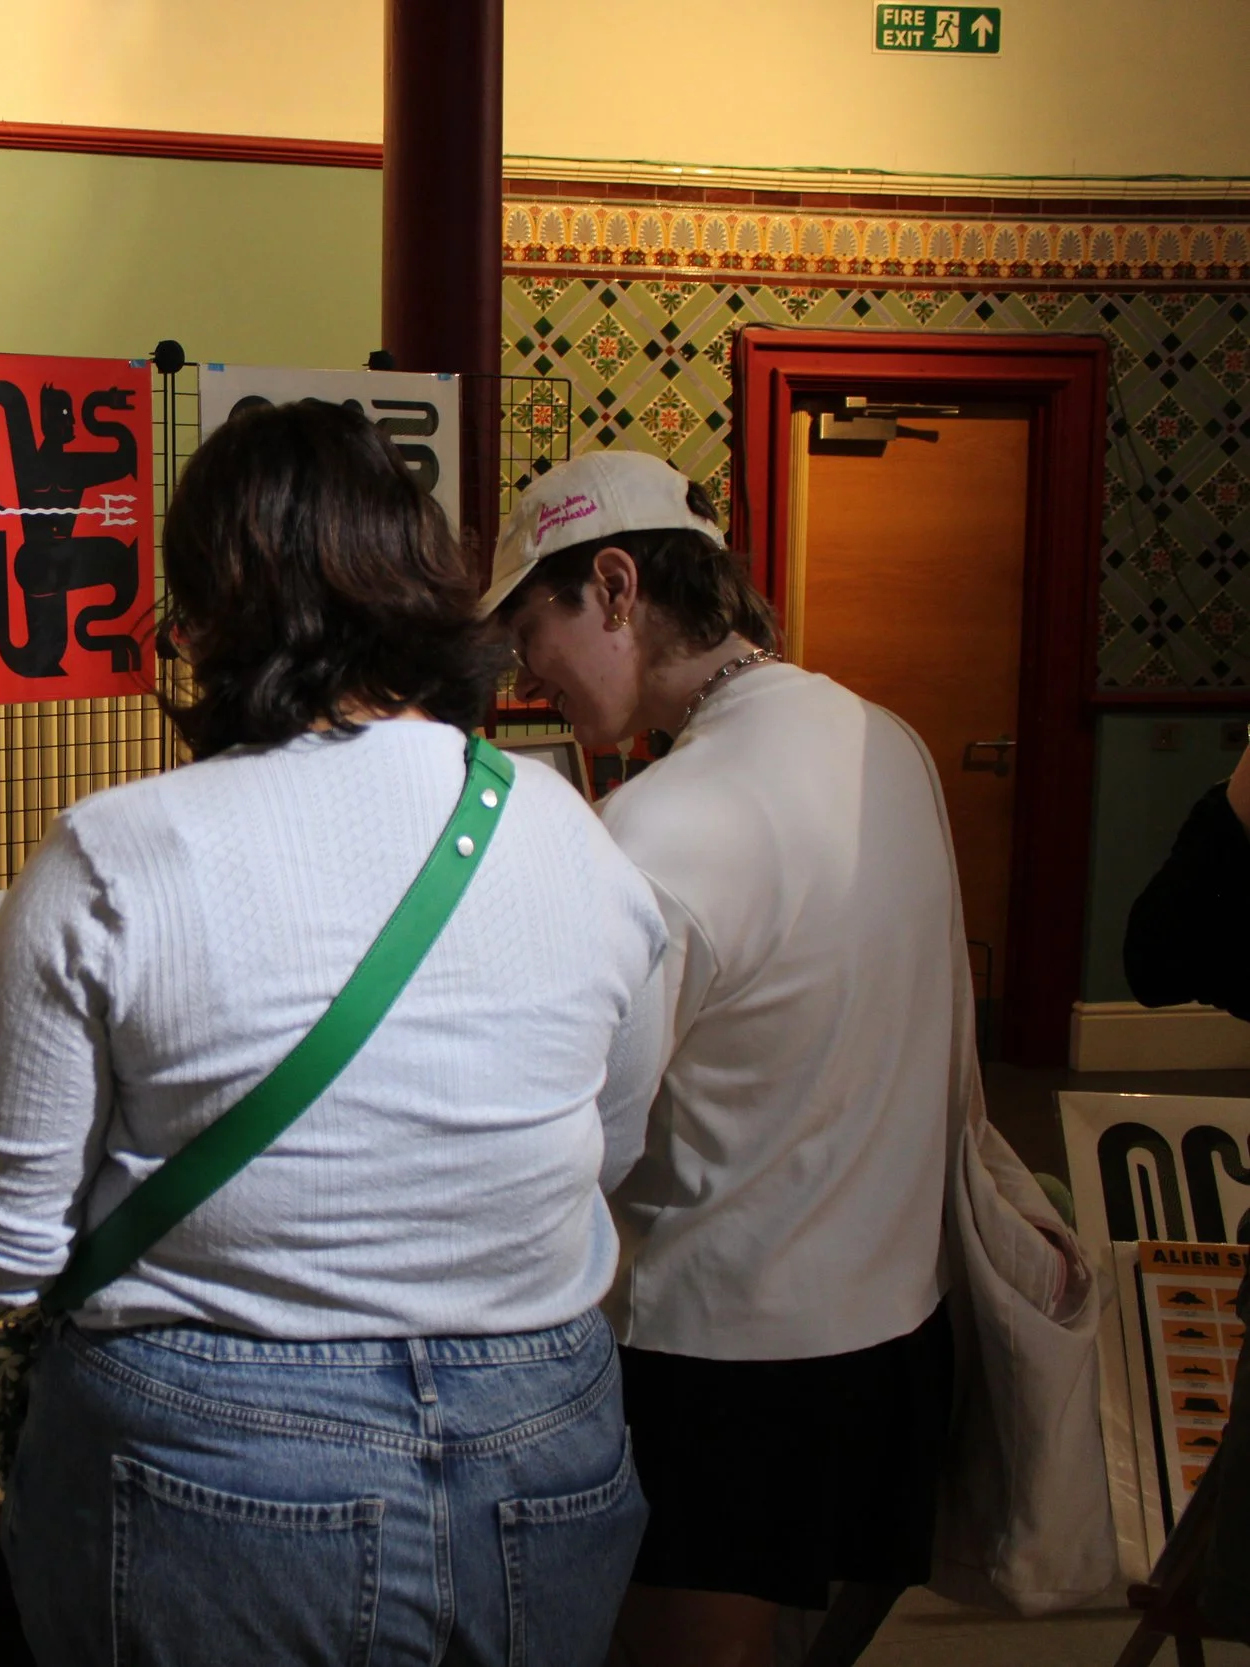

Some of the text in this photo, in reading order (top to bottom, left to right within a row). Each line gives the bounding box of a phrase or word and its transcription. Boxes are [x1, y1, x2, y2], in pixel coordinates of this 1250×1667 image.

[883, 8, 925, 26] FIRE
[882, 30, 925, 47] EXIT
[1153, 1249, 1220, 1266] ALIEN
